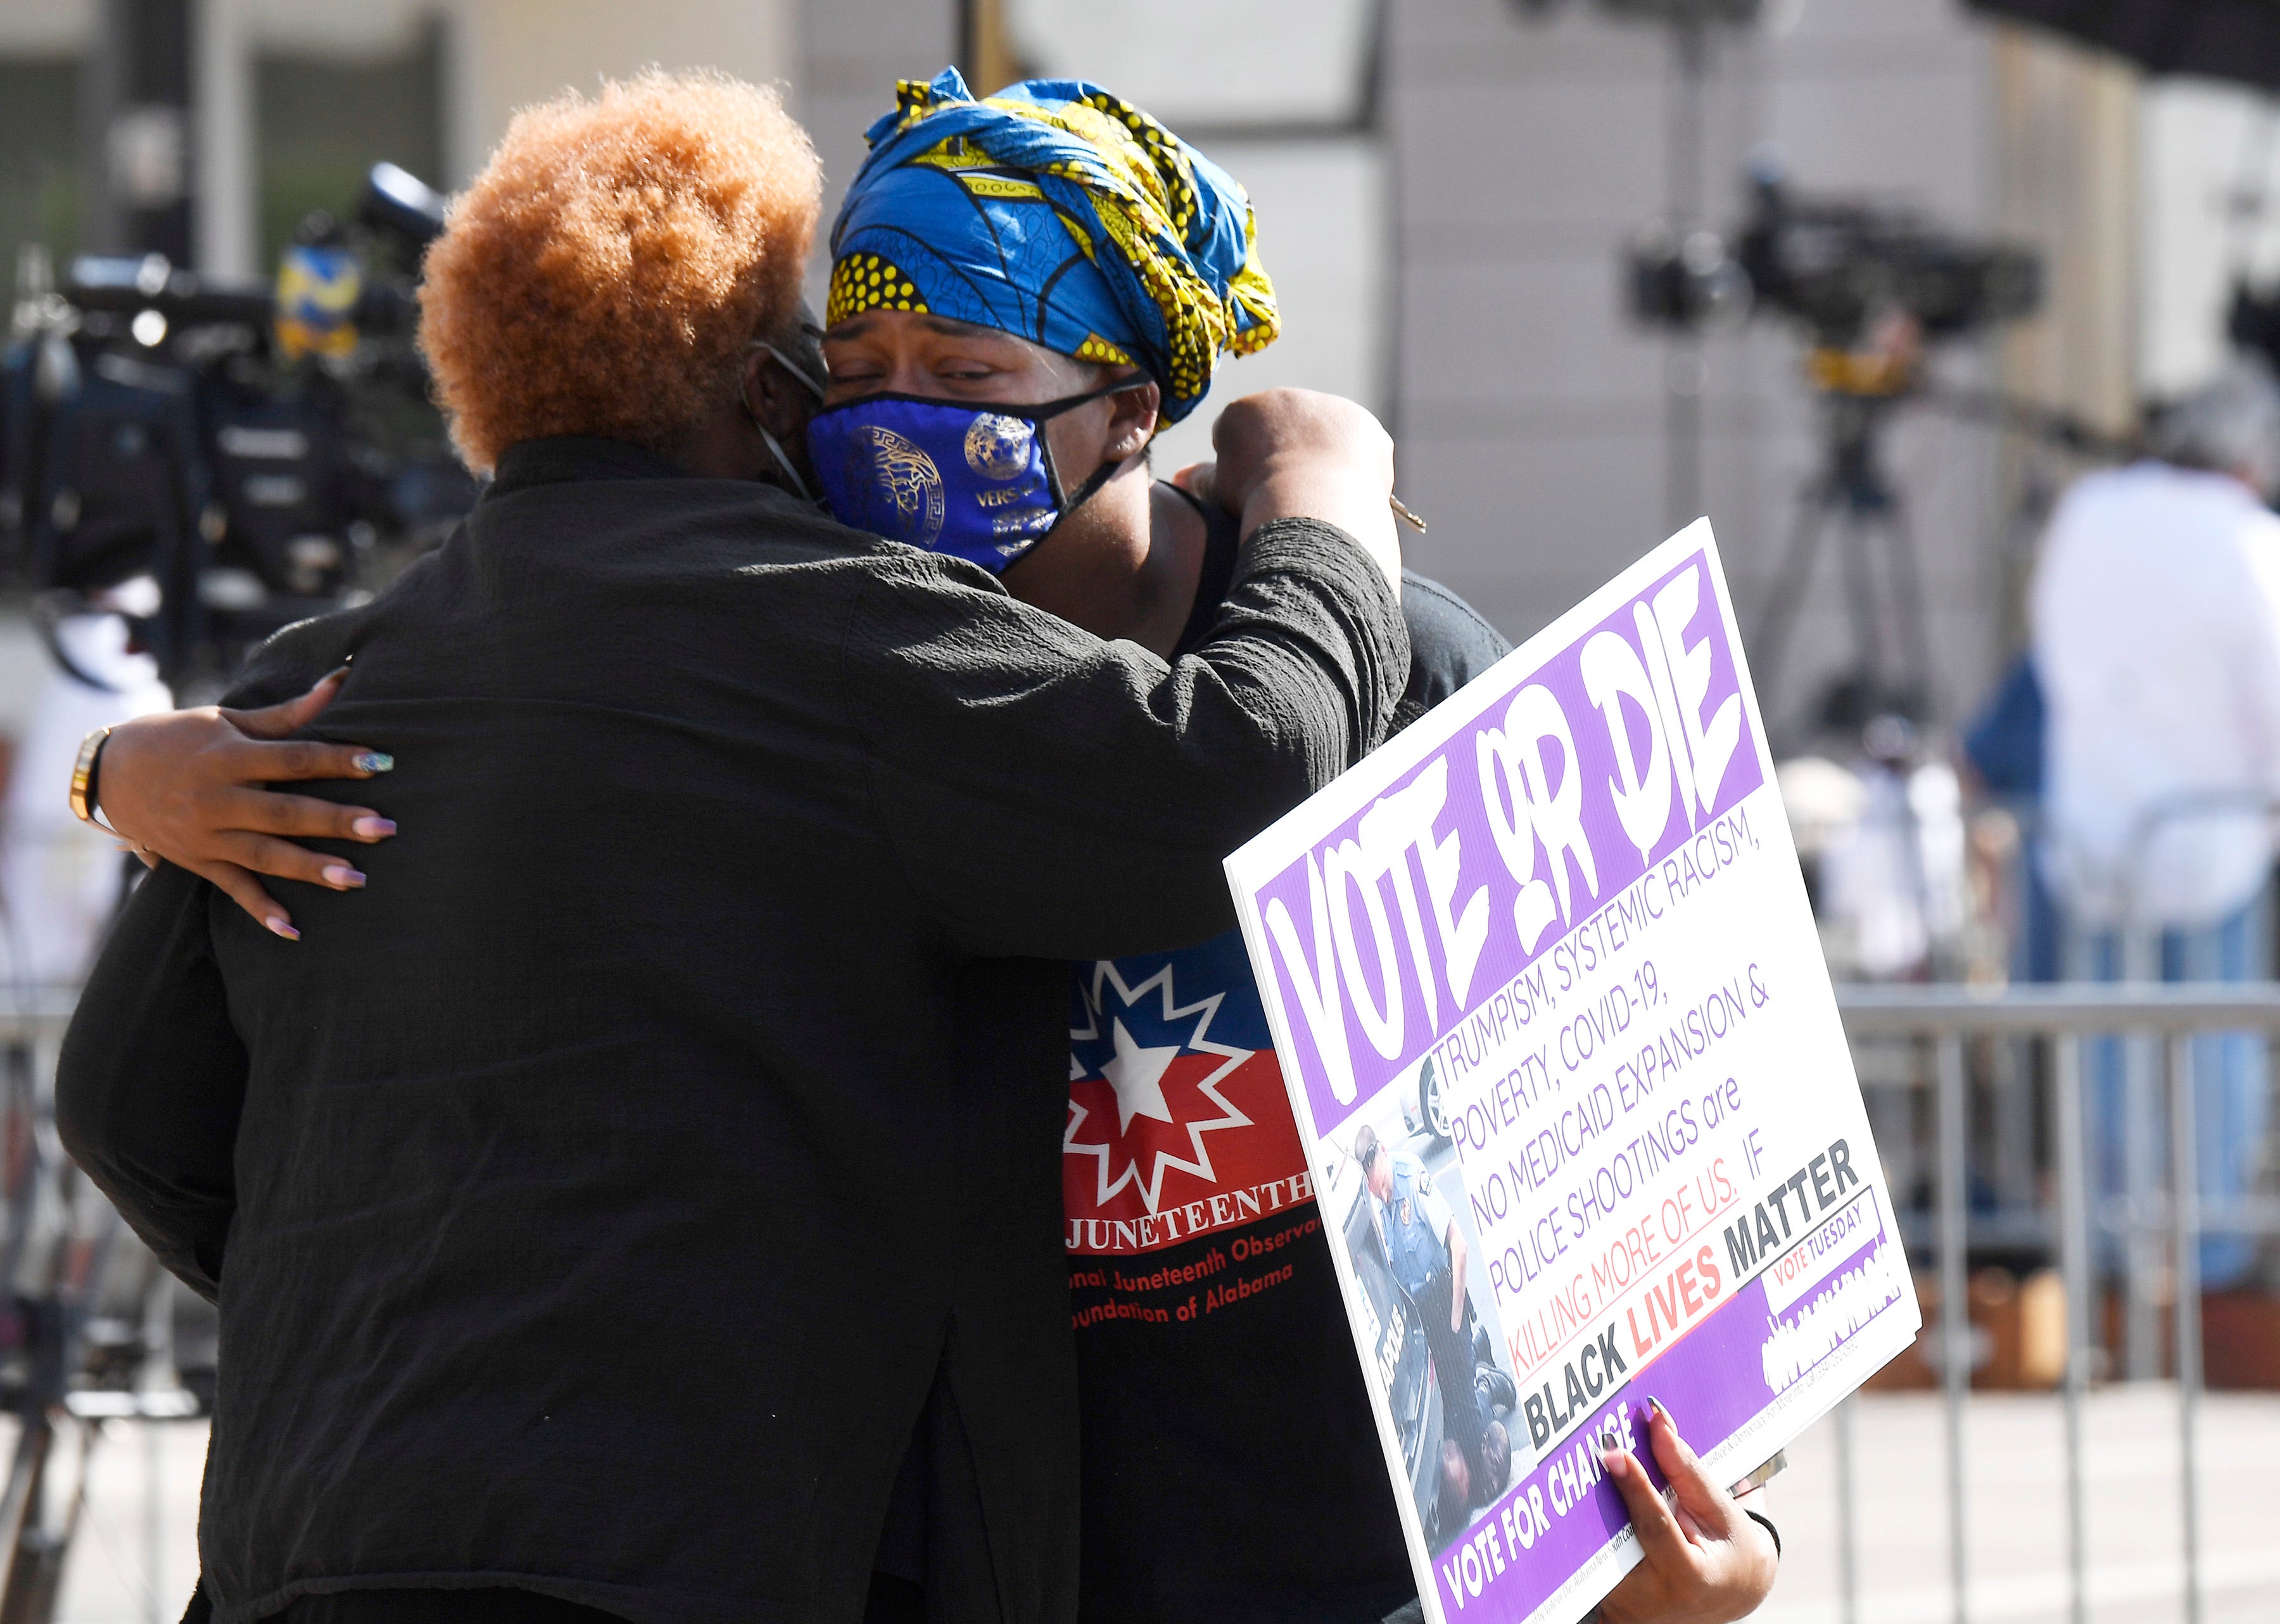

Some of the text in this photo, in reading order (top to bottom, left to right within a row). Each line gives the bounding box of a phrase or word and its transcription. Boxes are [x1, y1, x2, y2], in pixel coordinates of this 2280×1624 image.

[1265, 562, 1742, 1107] VOTE OR DIE
[1431, 805, 1759, 1089] TRUMPISM, SYSTEMIC RACISM,
[1452, 960, 1667, 1164] POVERTY, COVID-19,
[1471, 963, 1769, 1236] NO MEDICAID EXPANSION &
[1065, 1170, 1315, 1250] JUNETEENTH
[1113, 1247, 1227, 1292] Juneteenth
[1176, 1295, 1197, 1322] of
[1206, 1264, 1293, 1315] Alabama
[1490, 1077, 1741, 1307] POLICE SHOOTINGS are
[1508, 1127, 1763, 1378] KILLING MORE OF US. IF
[1524, 1138, 1859, 1451] BLACK LIVES MATTER
[1773, 1202, 1861, 1286] VOTE TUESDAY
[1442, 1521, 1506, 1611] VOTE
[1500, 1483, 1551, 1562] FOR
